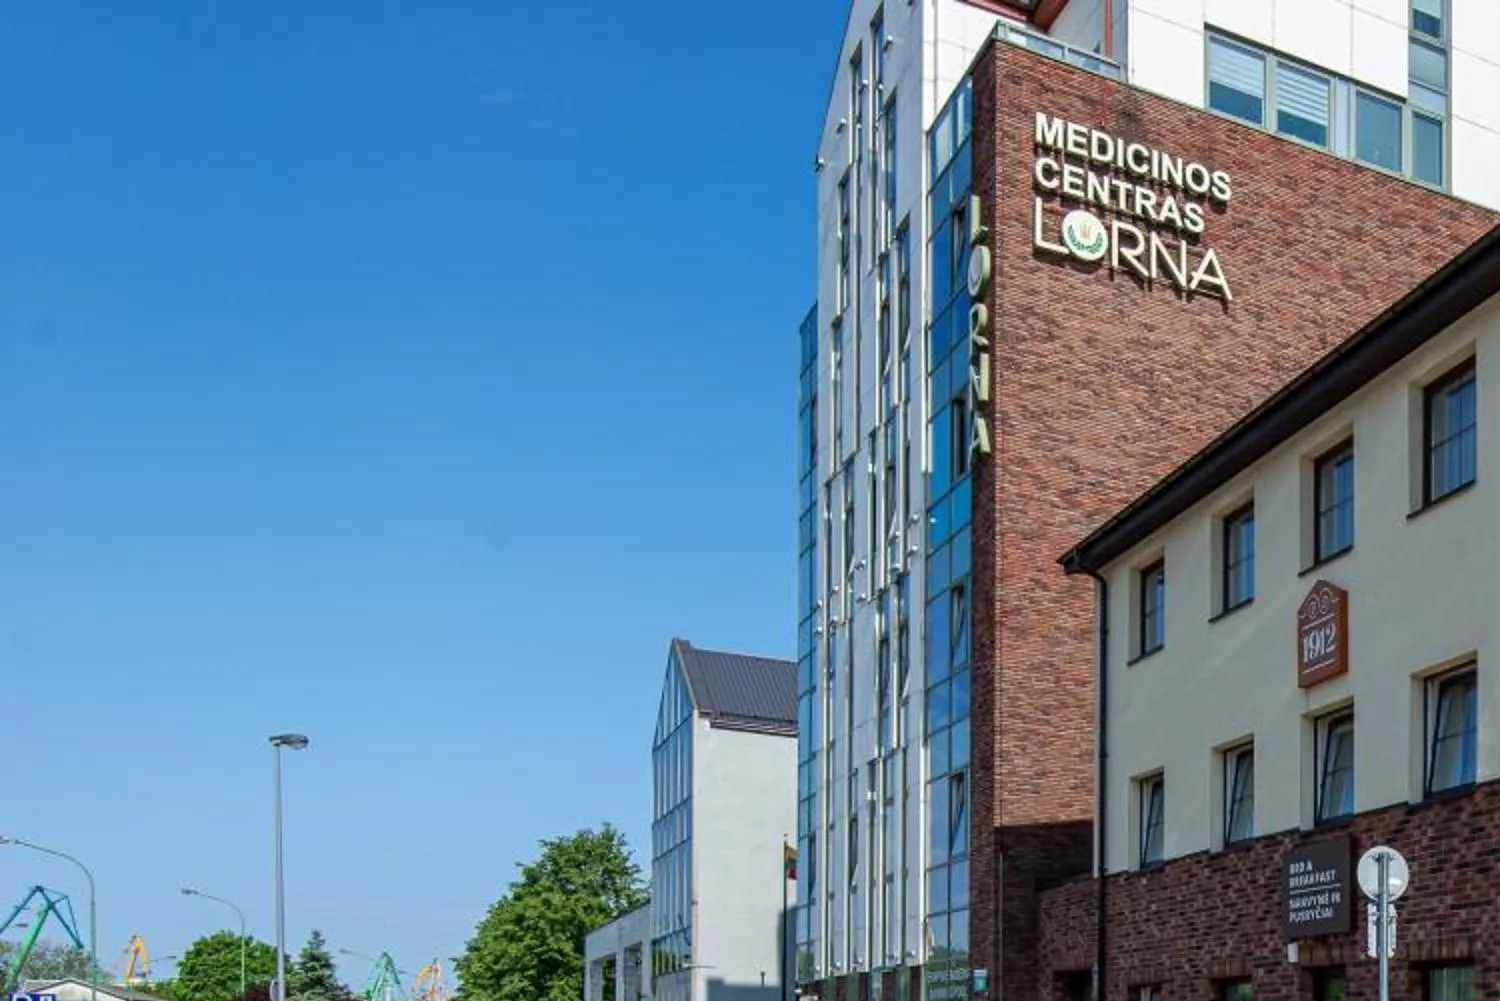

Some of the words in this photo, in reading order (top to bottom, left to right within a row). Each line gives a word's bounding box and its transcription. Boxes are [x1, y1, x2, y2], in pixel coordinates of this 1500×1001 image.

[1035, 111, 1232, 201] MEDICINOS
[1035, 157, 1205, 233] CENTRAS
[1034, 197, 1233, 300] LORNA
